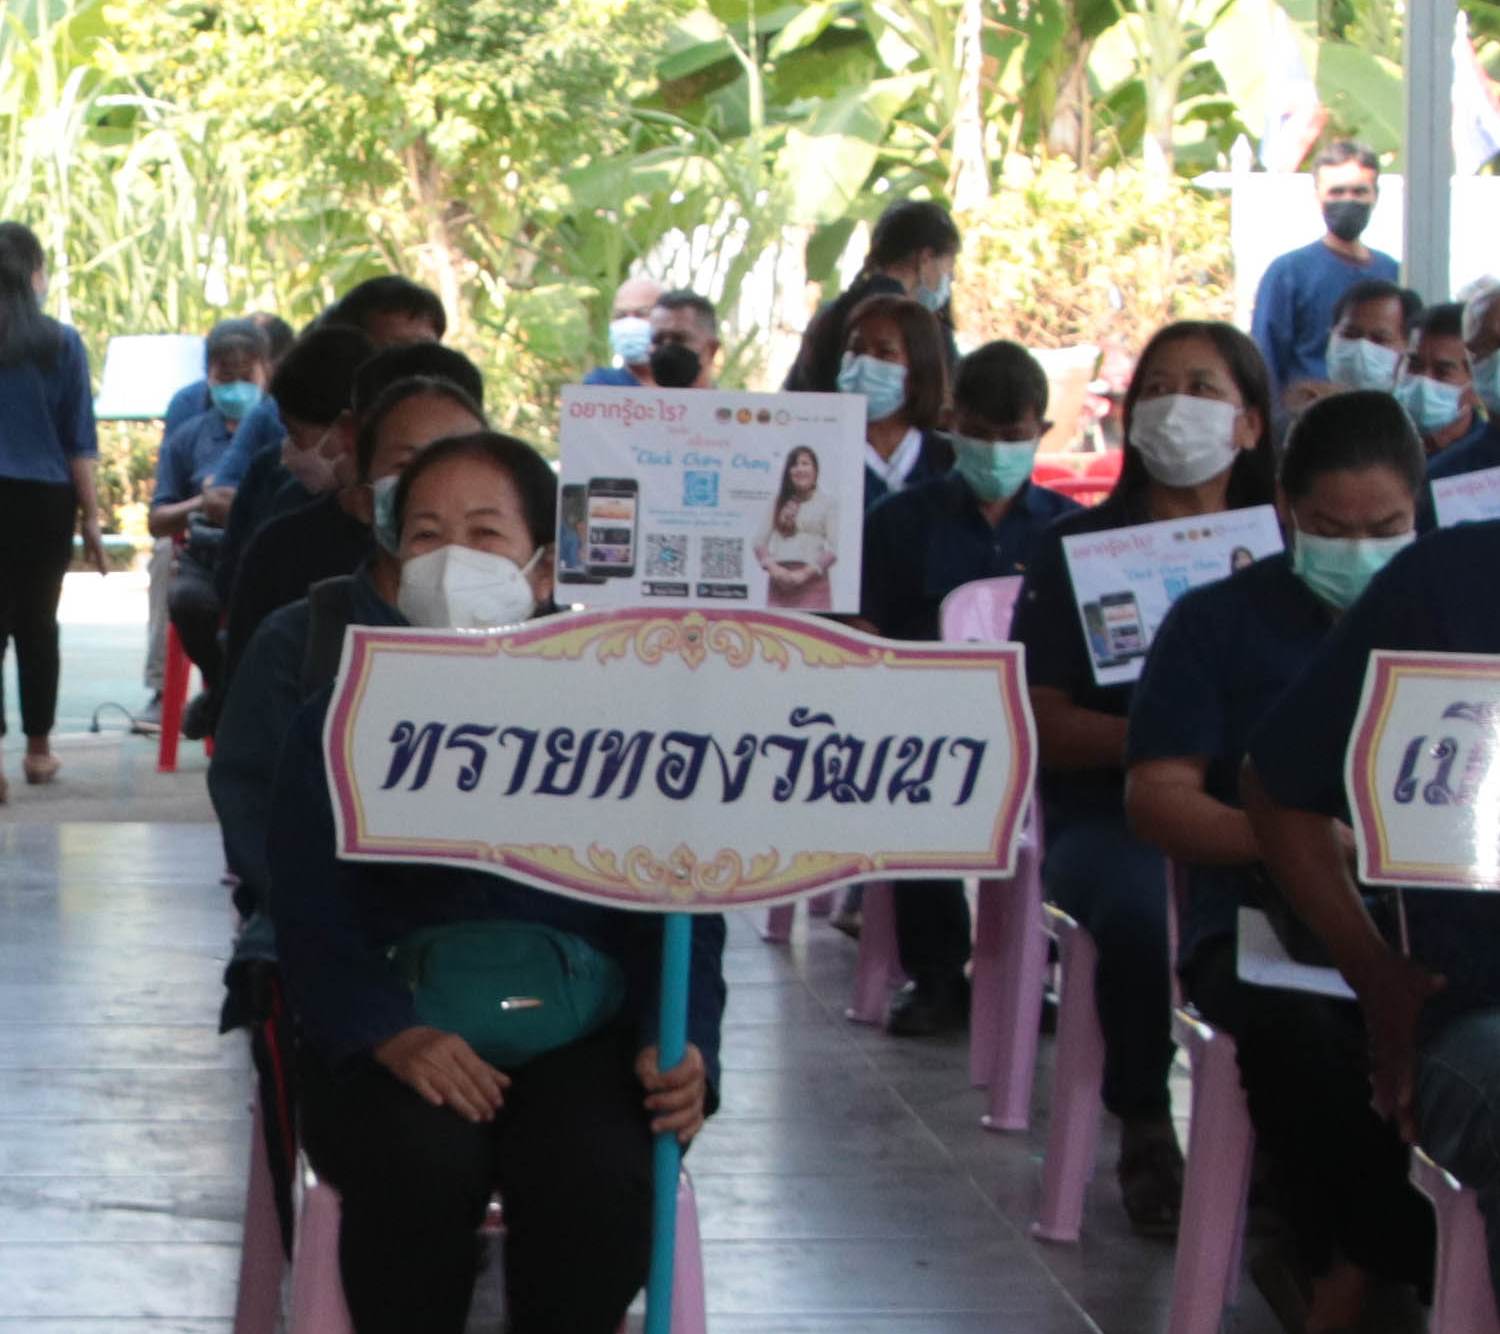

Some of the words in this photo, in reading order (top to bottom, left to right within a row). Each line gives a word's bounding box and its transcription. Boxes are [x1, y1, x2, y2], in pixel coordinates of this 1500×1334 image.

[569, 397, 688, 428] อยากรู้อะไร?
[379, 706, 988, 809] ทรายทองวัฒนา
